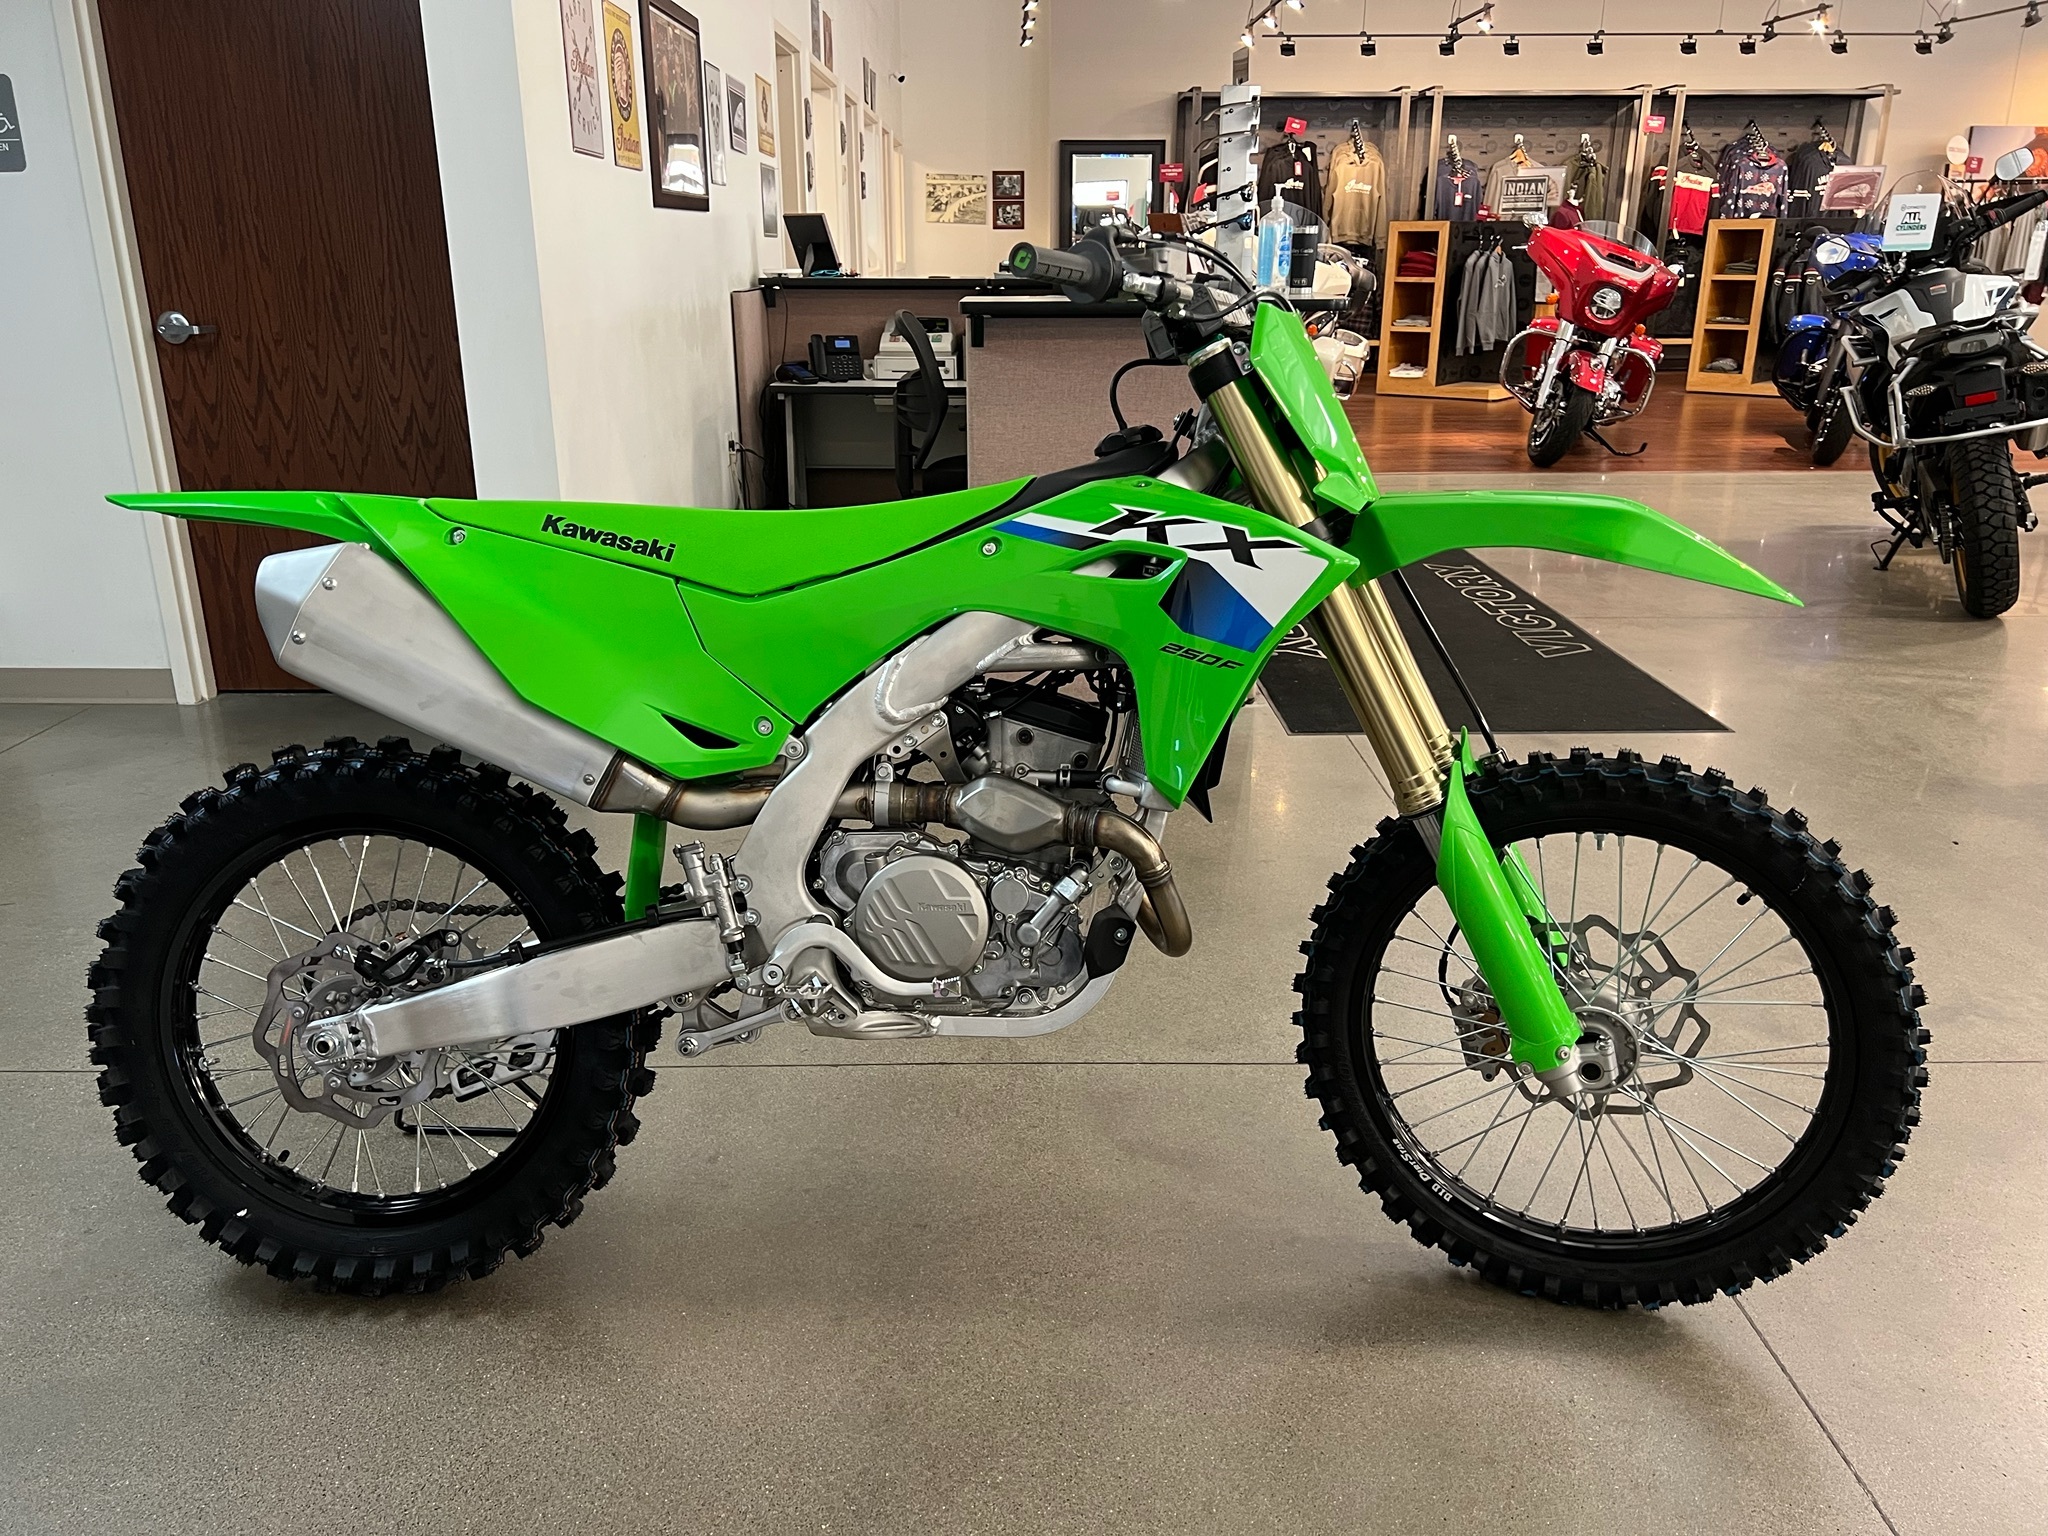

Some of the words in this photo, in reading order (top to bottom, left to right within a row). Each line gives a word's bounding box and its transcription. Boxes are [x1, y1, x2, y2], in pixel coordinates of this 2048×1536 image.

[615, 123, 640, 155] Indian
[1503, 181, 1546, 196] INDIAN
[1895, 224, 1927, 232] CYLINDERS
[1901, 211, 1921, 225] ALL
[541, 513, 677, 563] Kawasaki
[1088, 507, 1305, 571] KX
[1422, 563, 1593, 659] VICTORY
[1159, 642, 1244, 670] 250F
[917, 902, 967, 912] Kawasaki
[1431, 1182, 1453, 1203] DID
